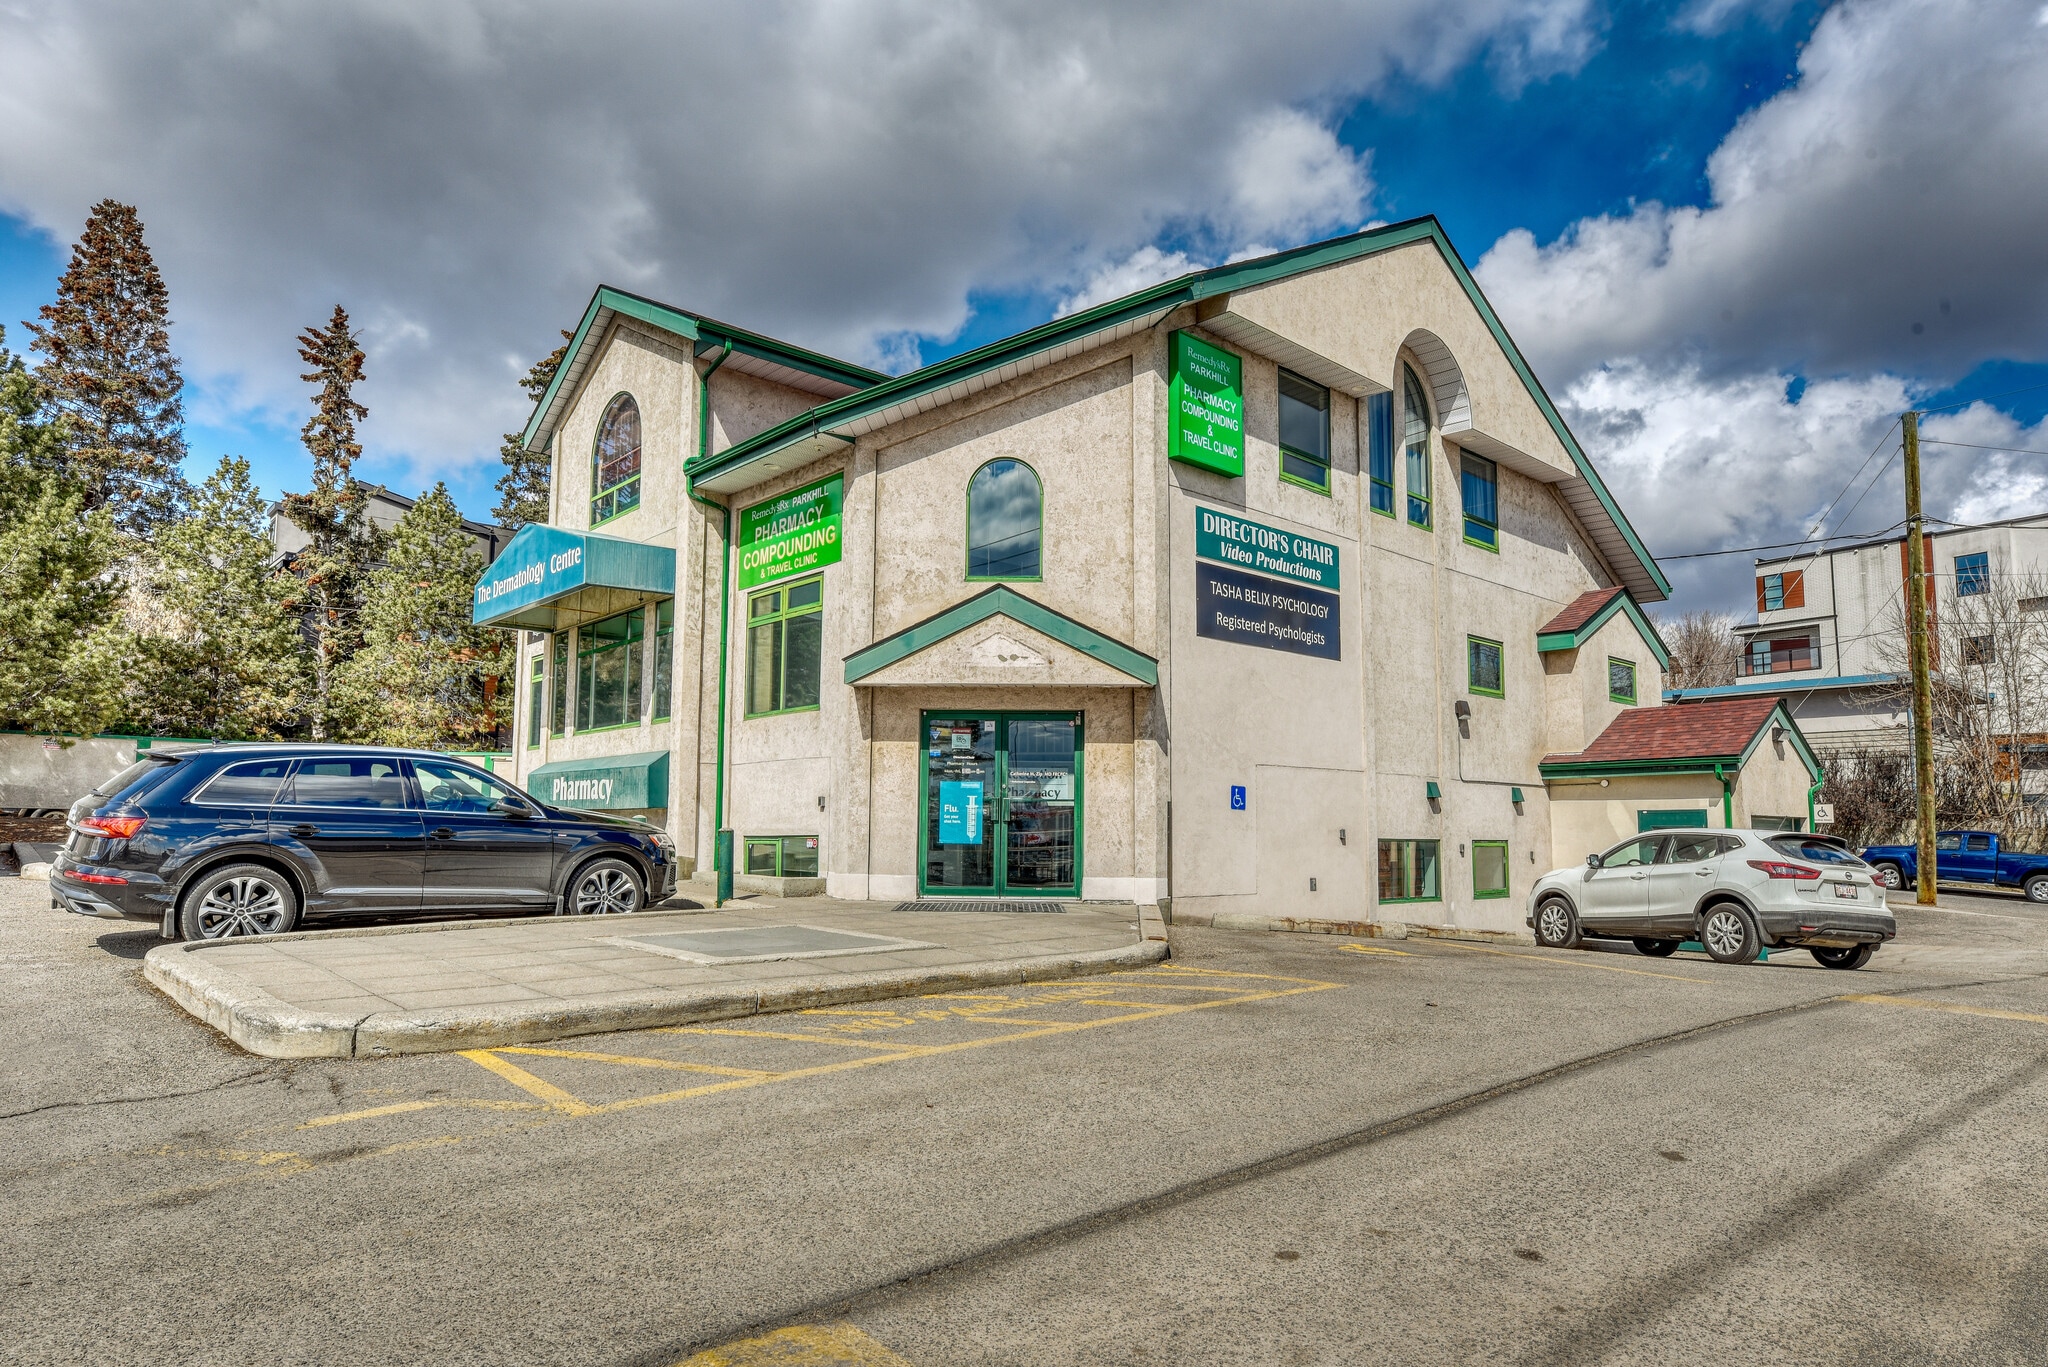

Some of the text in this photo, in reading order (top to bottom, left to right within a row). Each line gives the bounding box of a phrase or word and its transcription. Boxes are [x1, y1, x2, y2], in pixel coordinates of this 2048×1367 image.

[1190, 361, 1229, 387] PARKHILL
[1184, 383, 1237, 414] PHARMACY
[1181, 400, 1239, 431] COMPOUNDING
[1207, 424, 1213, 437] &
[1183, 429, 1238, 459] TRAVEL CLINIC
[792, 486, 829, 507] PARKHILL
[754, 504, 824, 545] PHARMACY
[1203, 512, 1334, 566] DIRECTOR'S CHAIR
[743, 525, 836, 570] COMPOUNDING
[1220, 541, 1322, 582] Video Productions
[477, 547, 581, 605] The Dermatology Centre
[760, 552, 818, 579] & TRAVEL CLINIC
[1210, 580, 1329, 619] TASHA BELIX PSYCHOLOGY
[1216, 611, 1325, 646] Registered Psychologists
[552, 776, 614, 805] Pharmacy
[944, 803, 959, 813] Flu.
